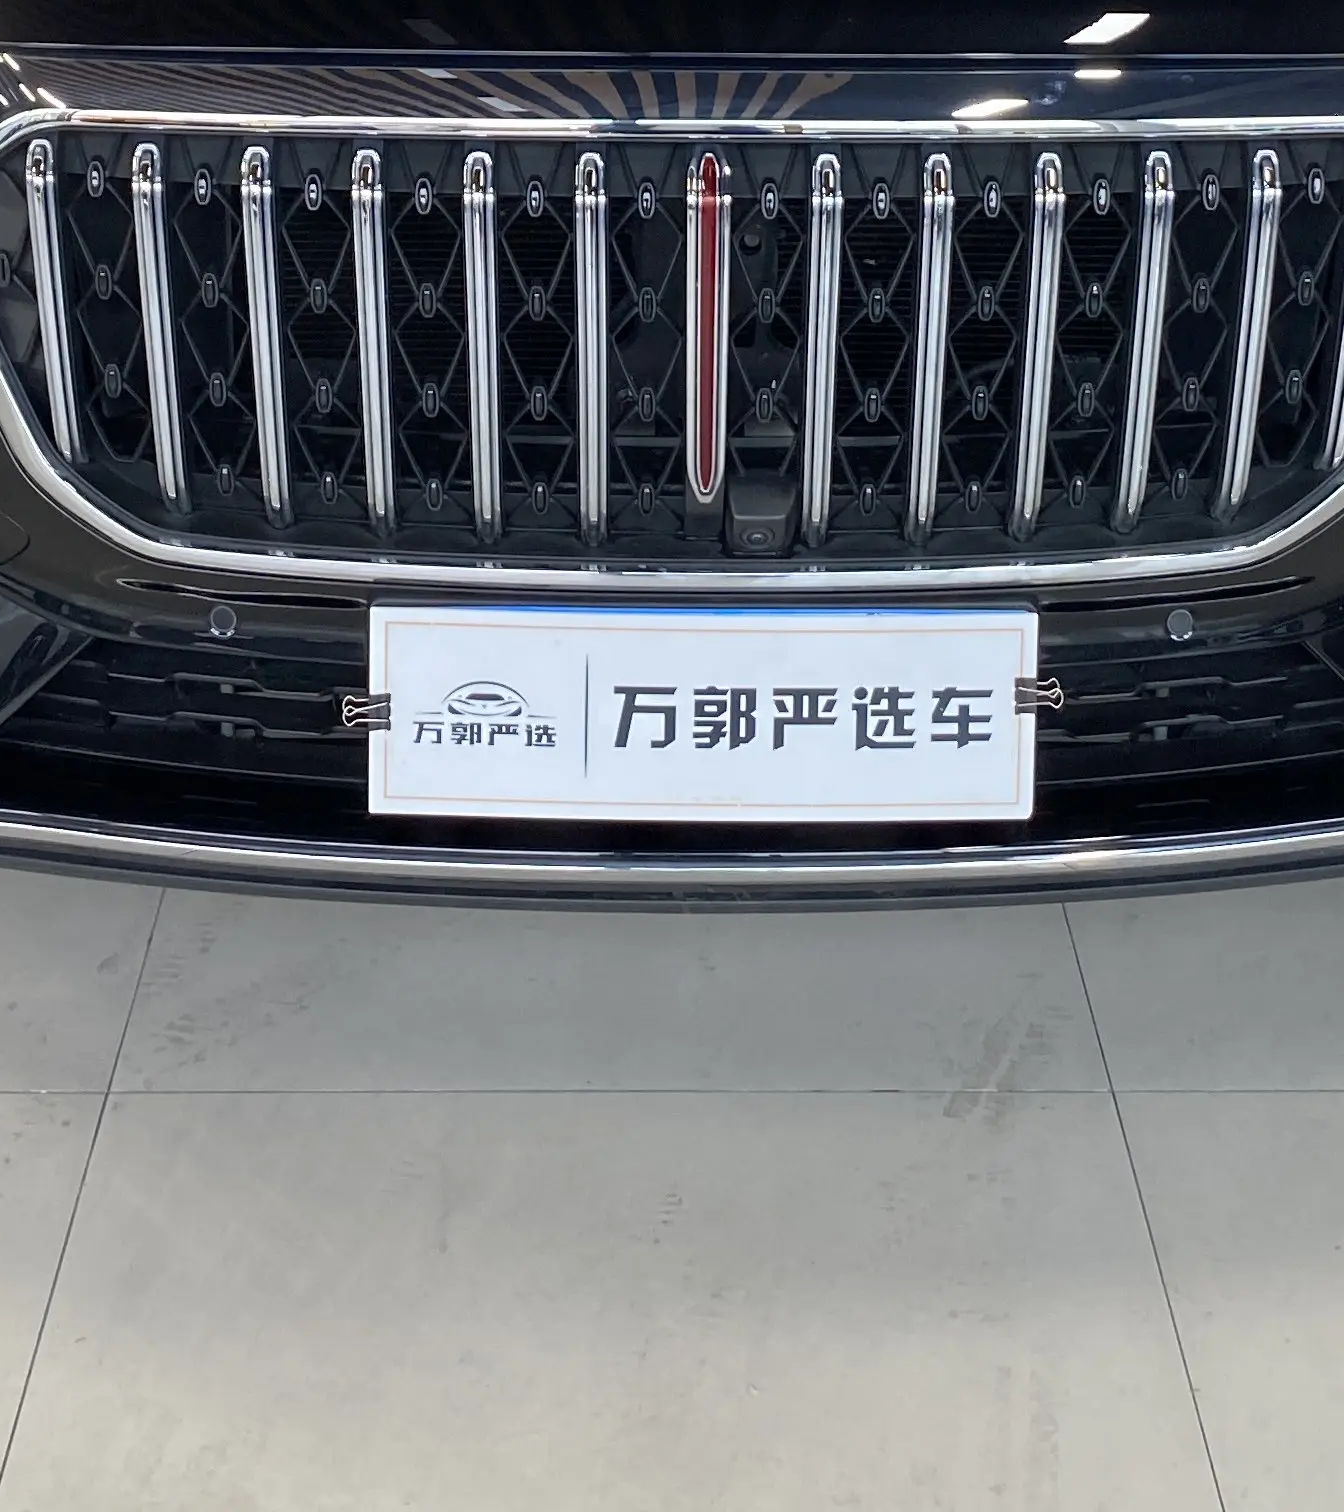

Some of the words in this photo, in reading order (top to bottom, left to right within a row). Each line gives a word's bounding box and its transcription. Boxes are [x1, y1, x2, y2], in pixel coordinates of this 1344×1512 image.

[413, 720, 557, 748] 万郭严选
[612, 684, 994, 751] 万郭严选车
